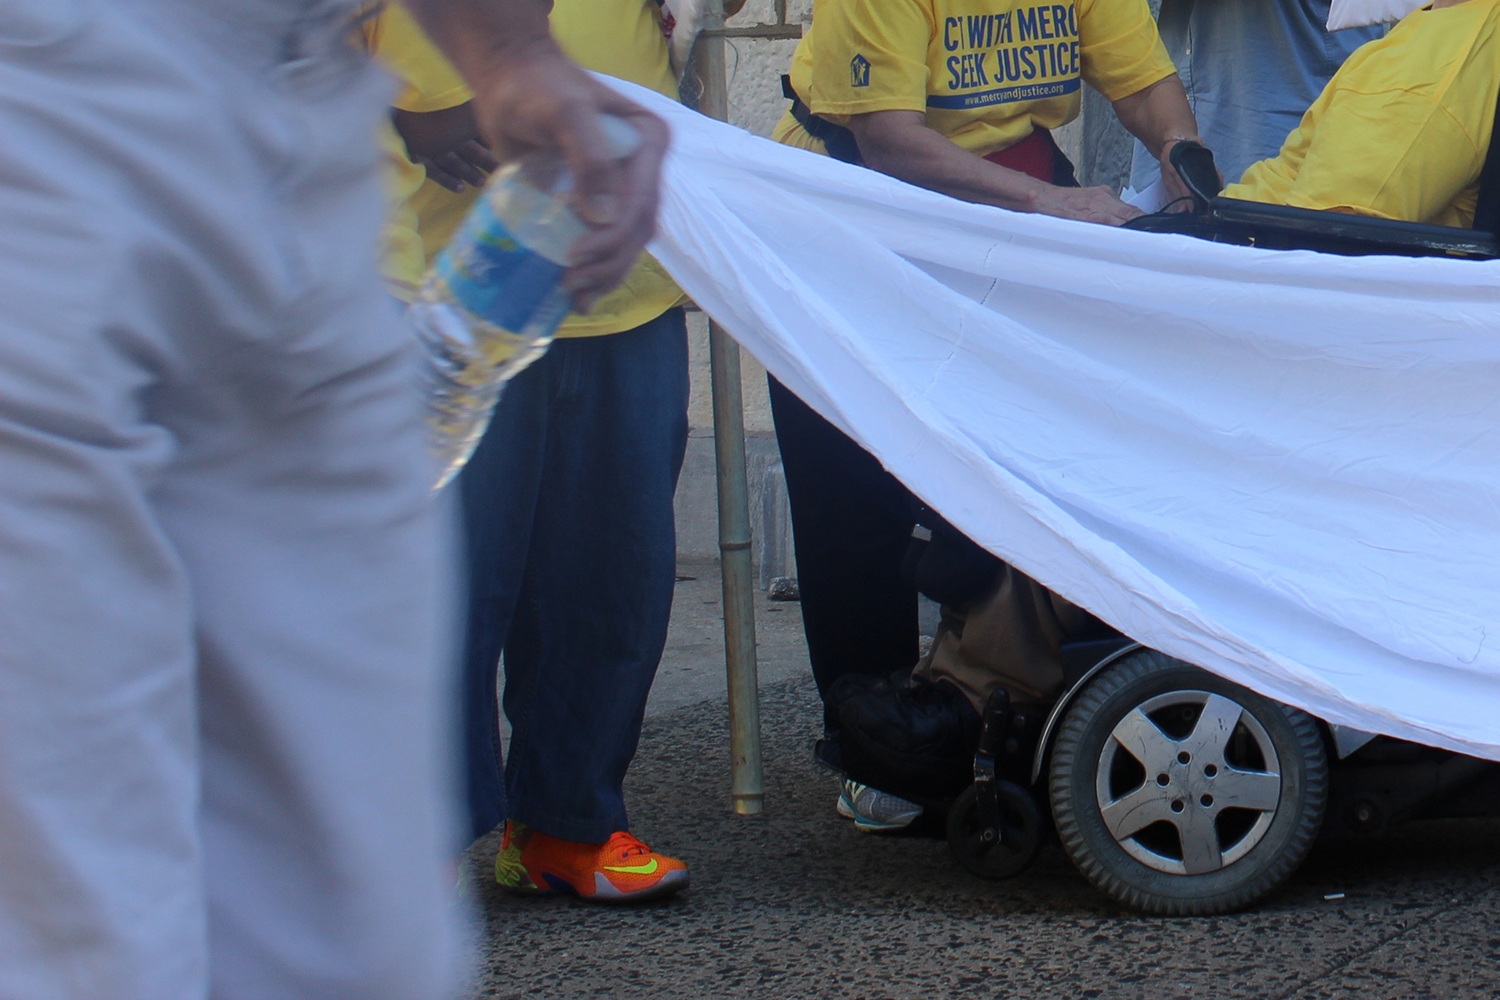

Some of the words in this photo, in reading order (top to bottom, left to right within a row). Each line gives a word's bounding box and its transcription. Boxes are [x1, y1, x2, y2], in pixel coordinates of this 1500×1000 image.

[966, 11, 1013, 49] WITH
[946, 53, 990, 91] SEEK
[993, 41, 1080, 84] JUSTICE
[964, 84, 1065, 106] www.mercyandjustice.org
